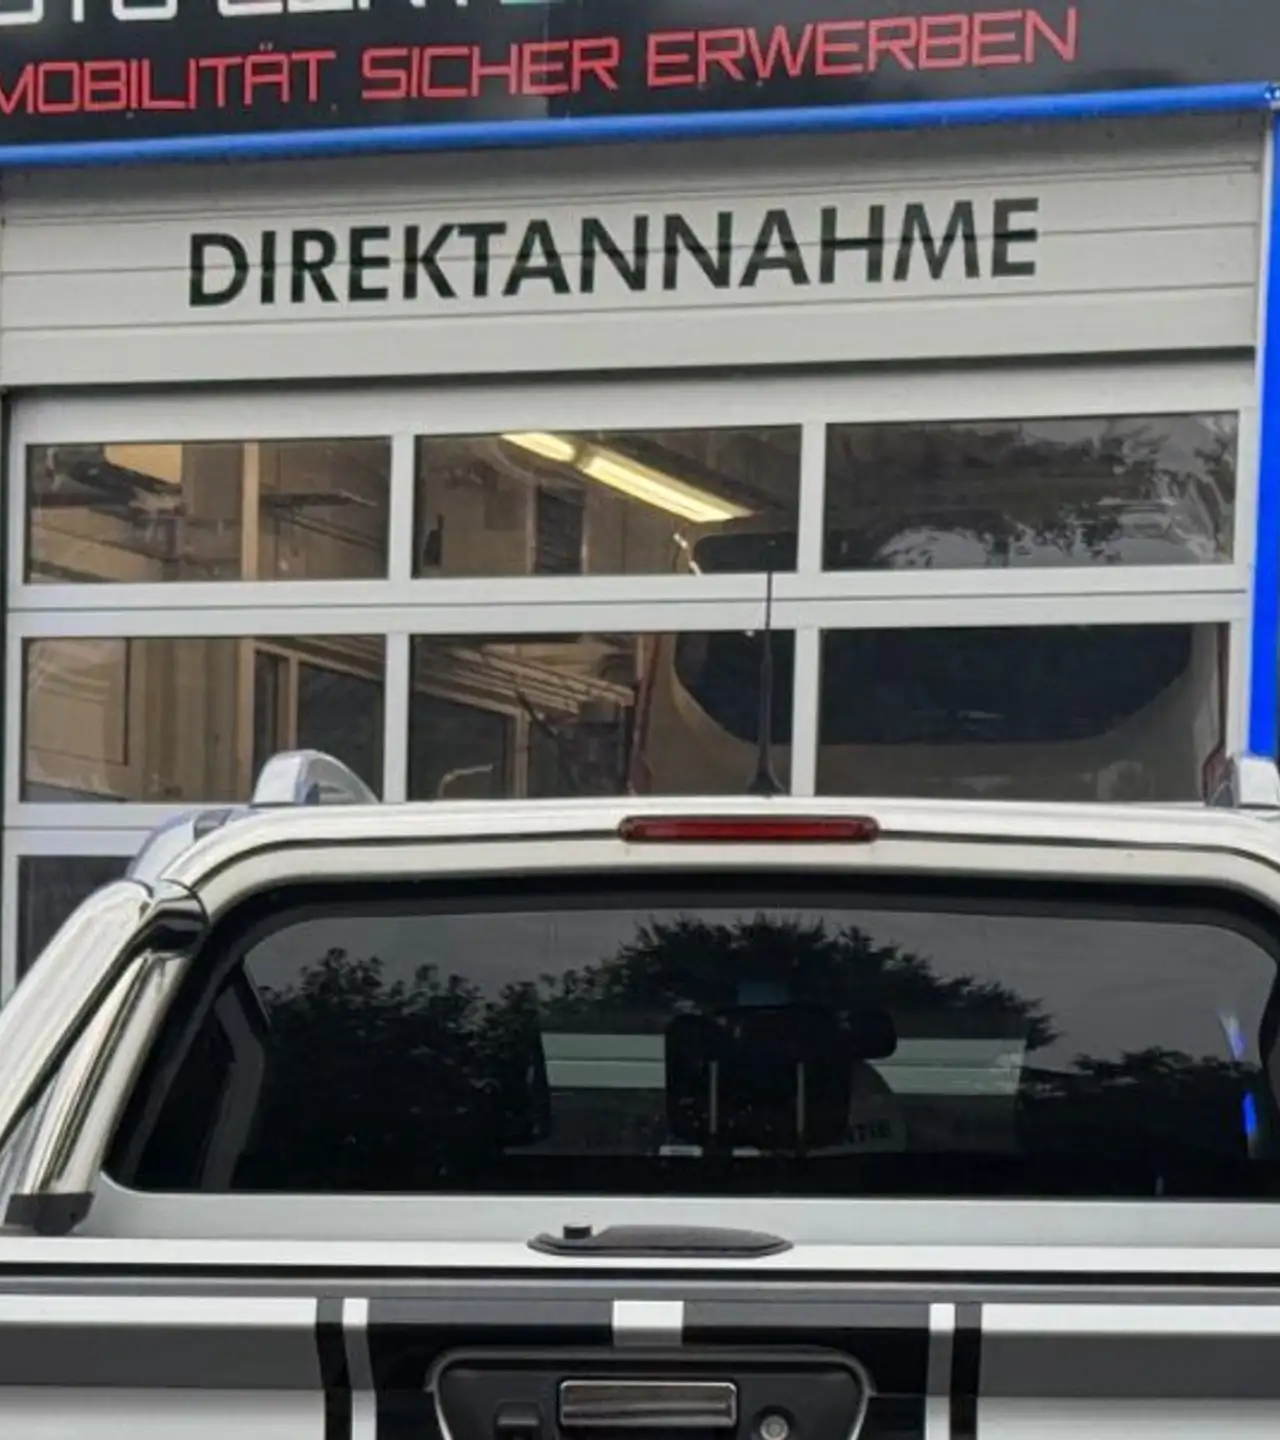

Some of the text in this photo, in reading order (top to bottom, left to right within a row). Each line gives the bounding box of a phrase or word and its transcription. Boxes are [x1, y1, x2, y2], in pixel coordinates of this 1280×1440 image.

[361, 36, 620, 102] SICHER
[646, 7, 1078, 88] ERWERBEN
[187, 197, 1041, 307] DIREKTANNAHME
